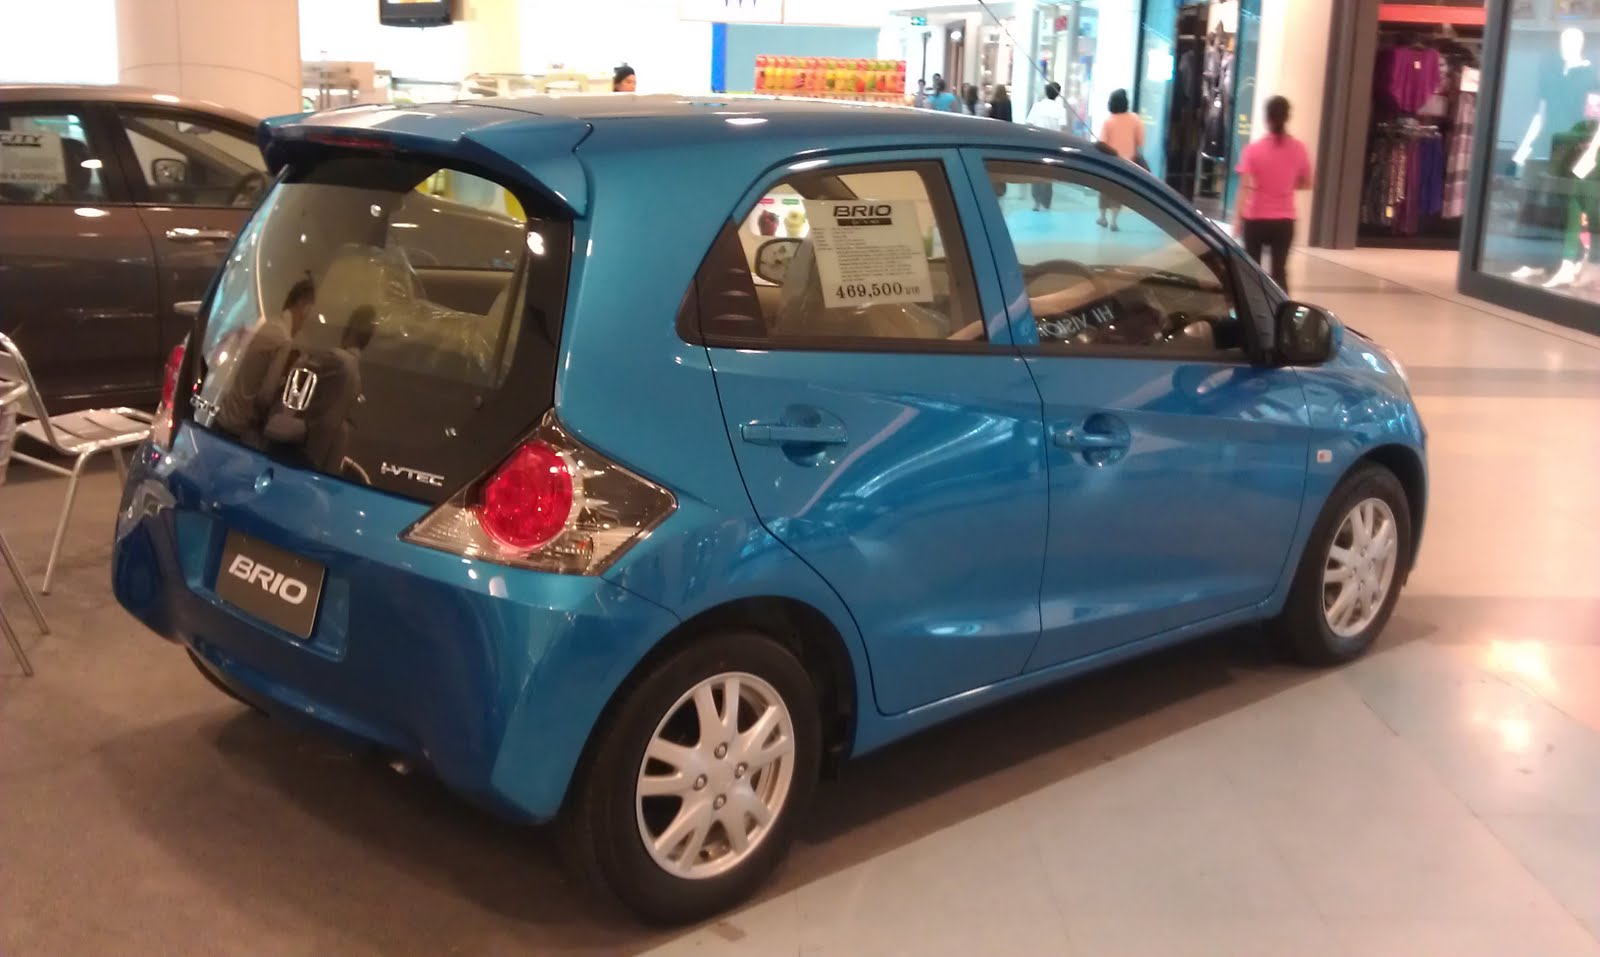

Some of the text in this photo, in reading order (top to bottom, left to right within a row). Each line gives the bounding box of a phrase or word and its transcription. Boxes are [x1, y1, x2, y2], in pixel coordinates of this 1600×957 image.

[833, 205, 892, 217] BRIO
[836, 282, 902, 298] 469,500
[228, 553, 308, 605] BRIO
